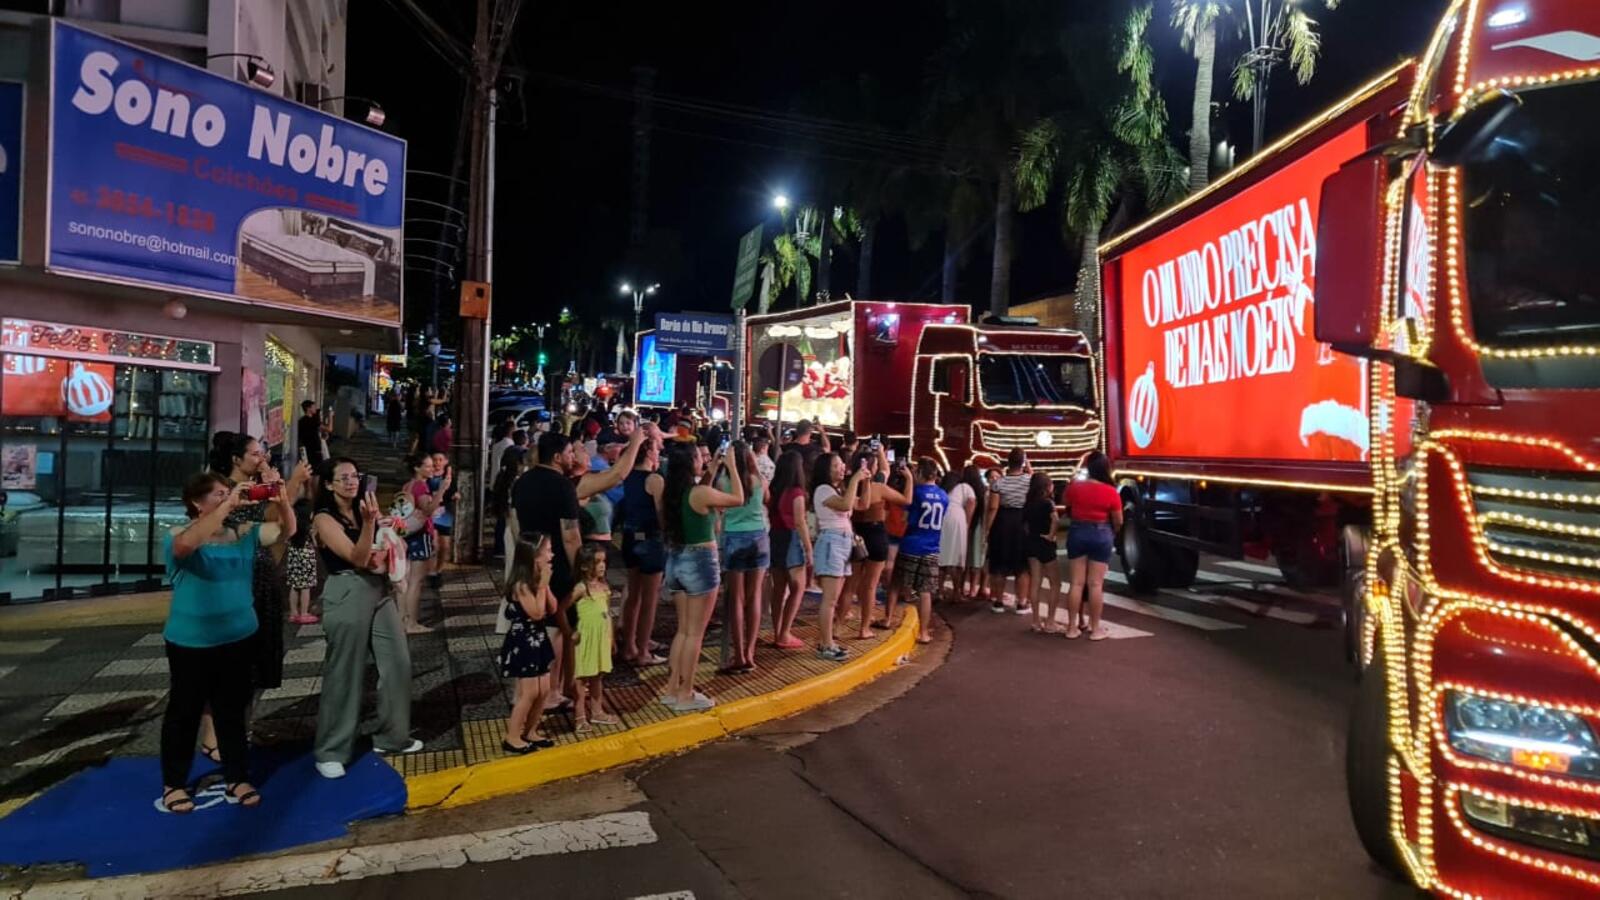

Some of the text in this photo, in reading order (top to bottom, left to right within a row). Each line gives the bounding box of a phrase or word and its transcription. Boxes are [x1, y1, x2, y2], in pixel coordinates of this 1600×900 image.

[71, 51, 389, 196] Sono Nobre
[67, 220, 238, 267] sononobre@hotmail.com
[1142, 197, 1316, 327] O MUNDO PRECISA
[30, 325, 92, 352] Feliz
[1164, 290, 1296, 388] DE MAIS NOÉIS
[919, 502, 943, 530] 20
